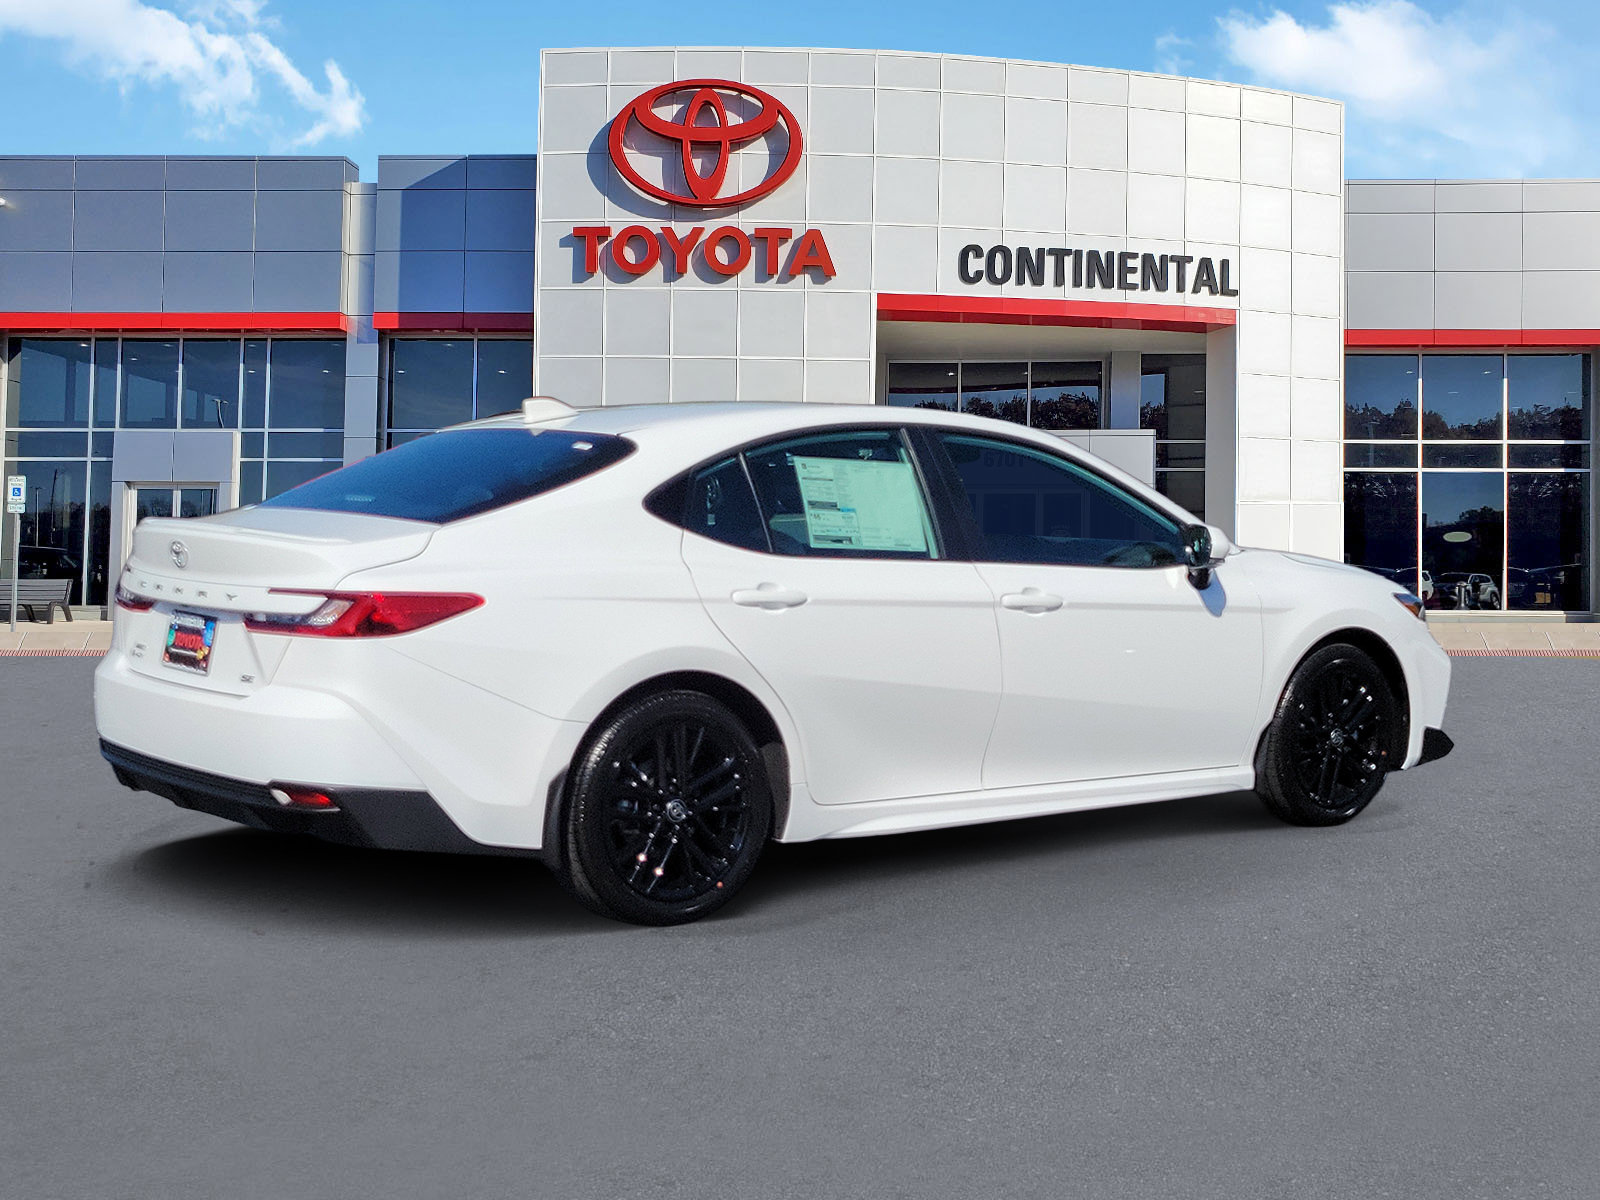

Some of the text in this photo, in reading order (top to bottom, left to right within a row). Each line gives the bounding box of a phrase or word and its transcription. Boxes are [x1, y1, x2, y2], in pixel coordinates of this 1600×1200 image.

[572, 225, 836, 277] TOYOTA
[959, 244, 1239, 297] CONTINENTAL
[140, 581, 238, 601] CAMRY
[241, 675, 255, 683] SE
